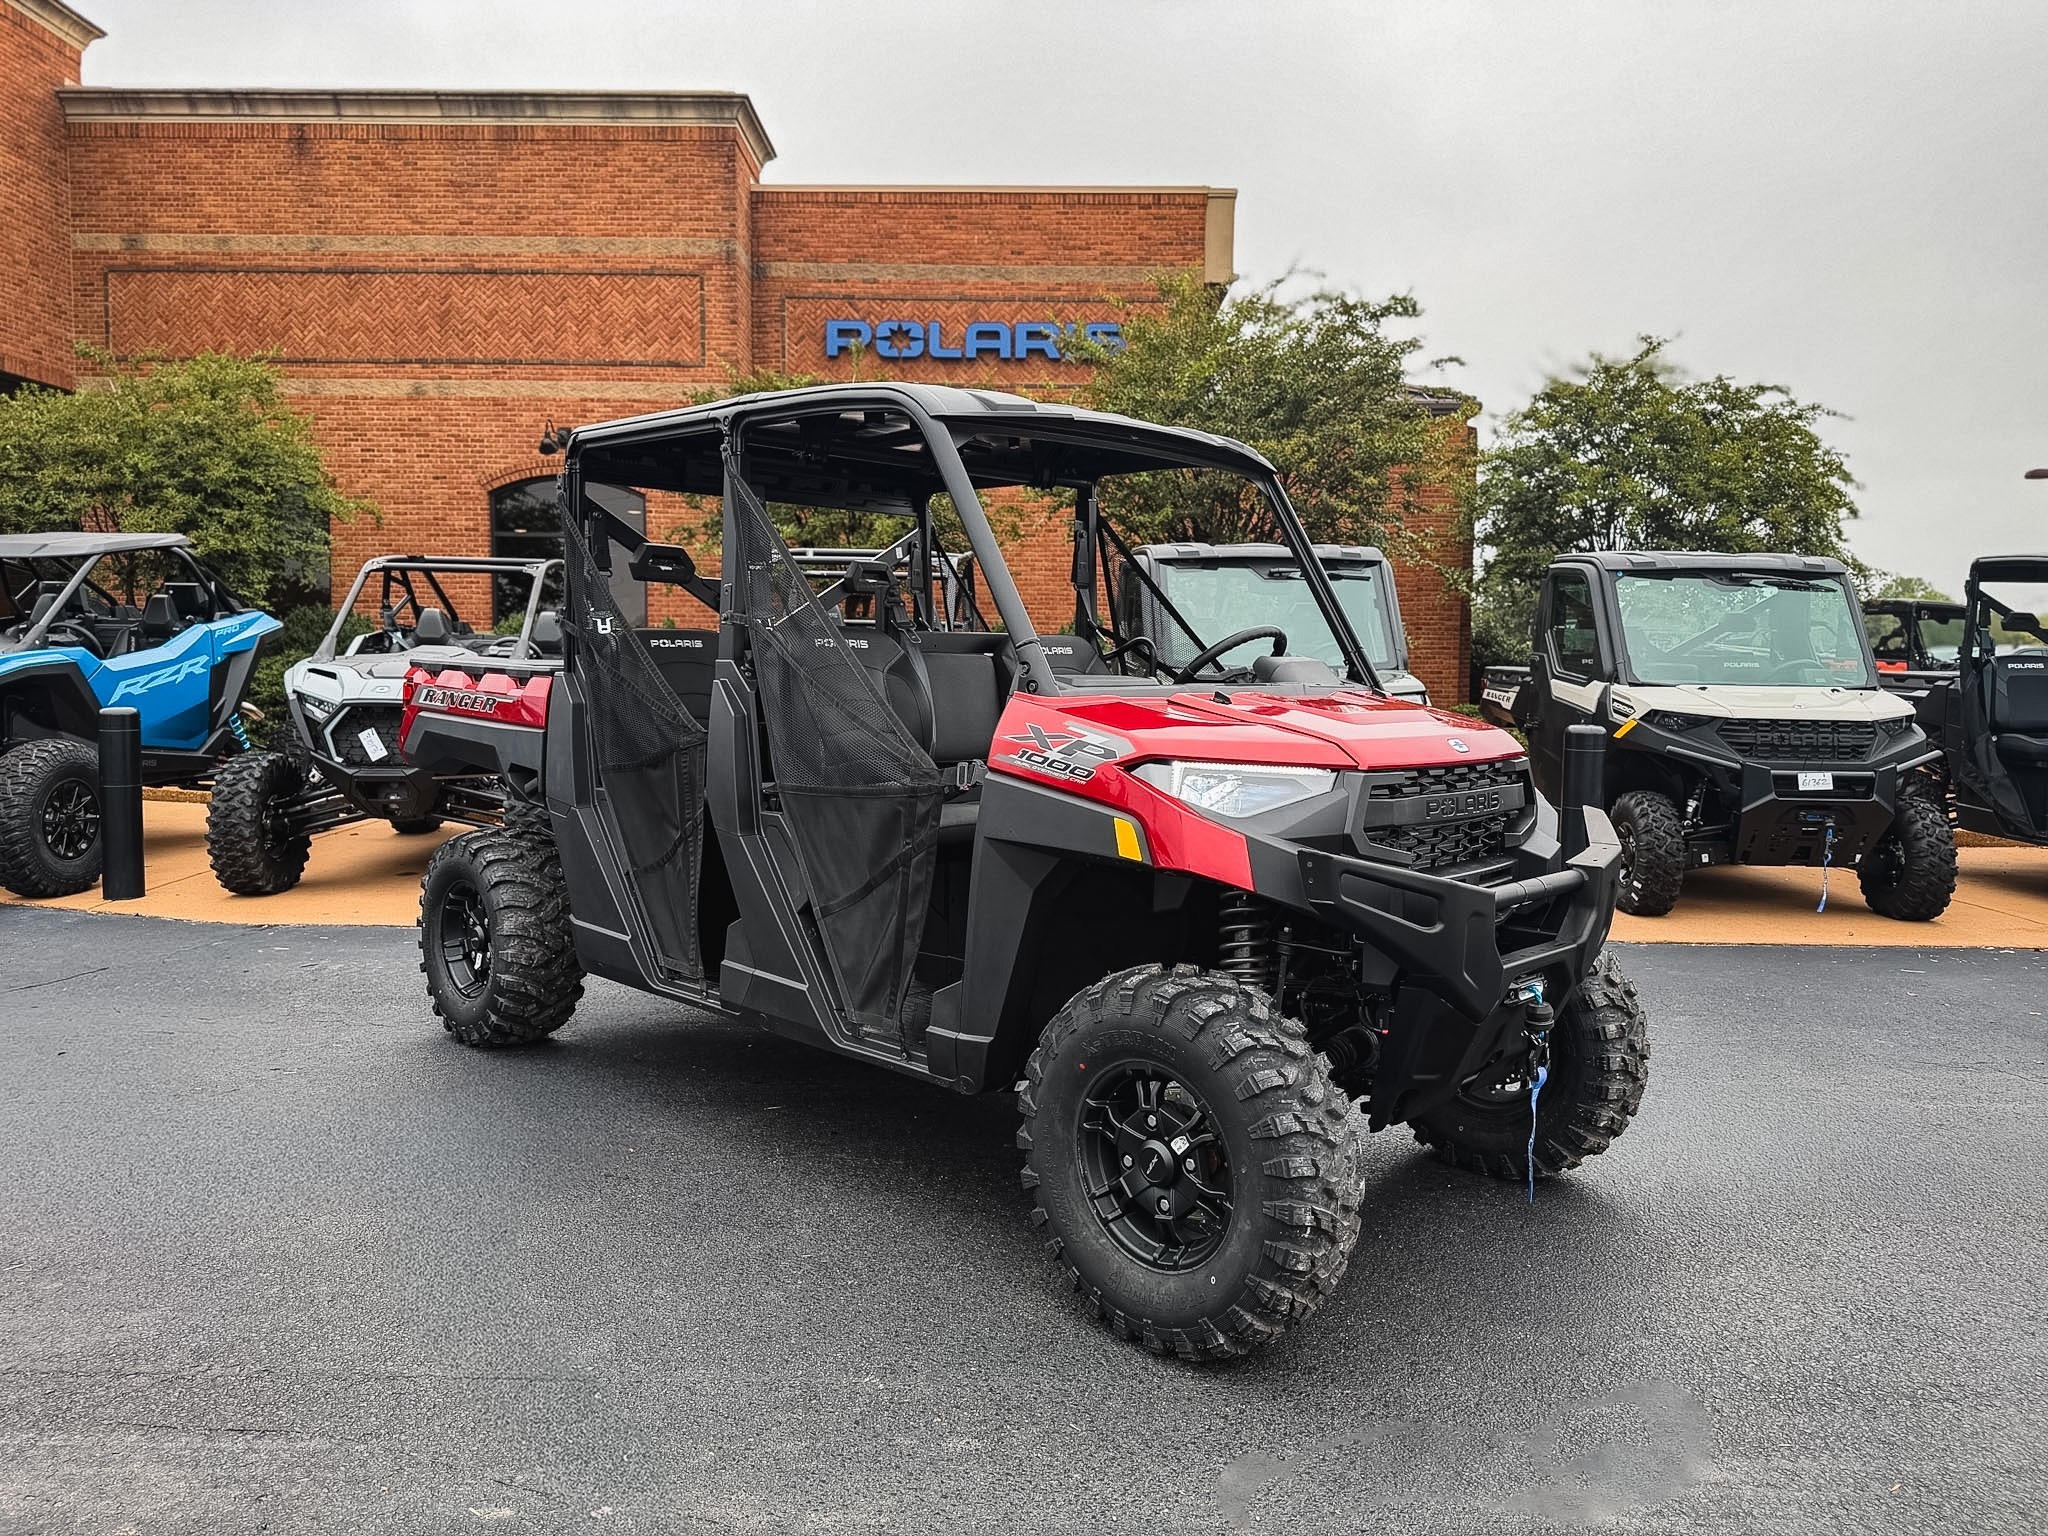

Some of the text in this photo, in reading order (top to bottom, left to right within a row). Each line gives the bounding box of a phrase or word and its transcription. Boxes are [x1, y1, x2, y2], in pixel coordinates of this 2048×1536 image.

[214, 624, 240, 638] PRO
[649, 639, 704, 648] POLARIS
[814, 638, 869, 649] PORIS
[1041, 646, 1073, 655] OLARIS
[107, 654, 210, 706] RZR
[421, 687, 499, 713] RANGER
[1486, 691, 1512, 703] RANGER
[1000, 721, 1120, 762] XP
[1016, 748, 1097, 781] 1000
[1425, 791, 1501, 820] POLARIS
